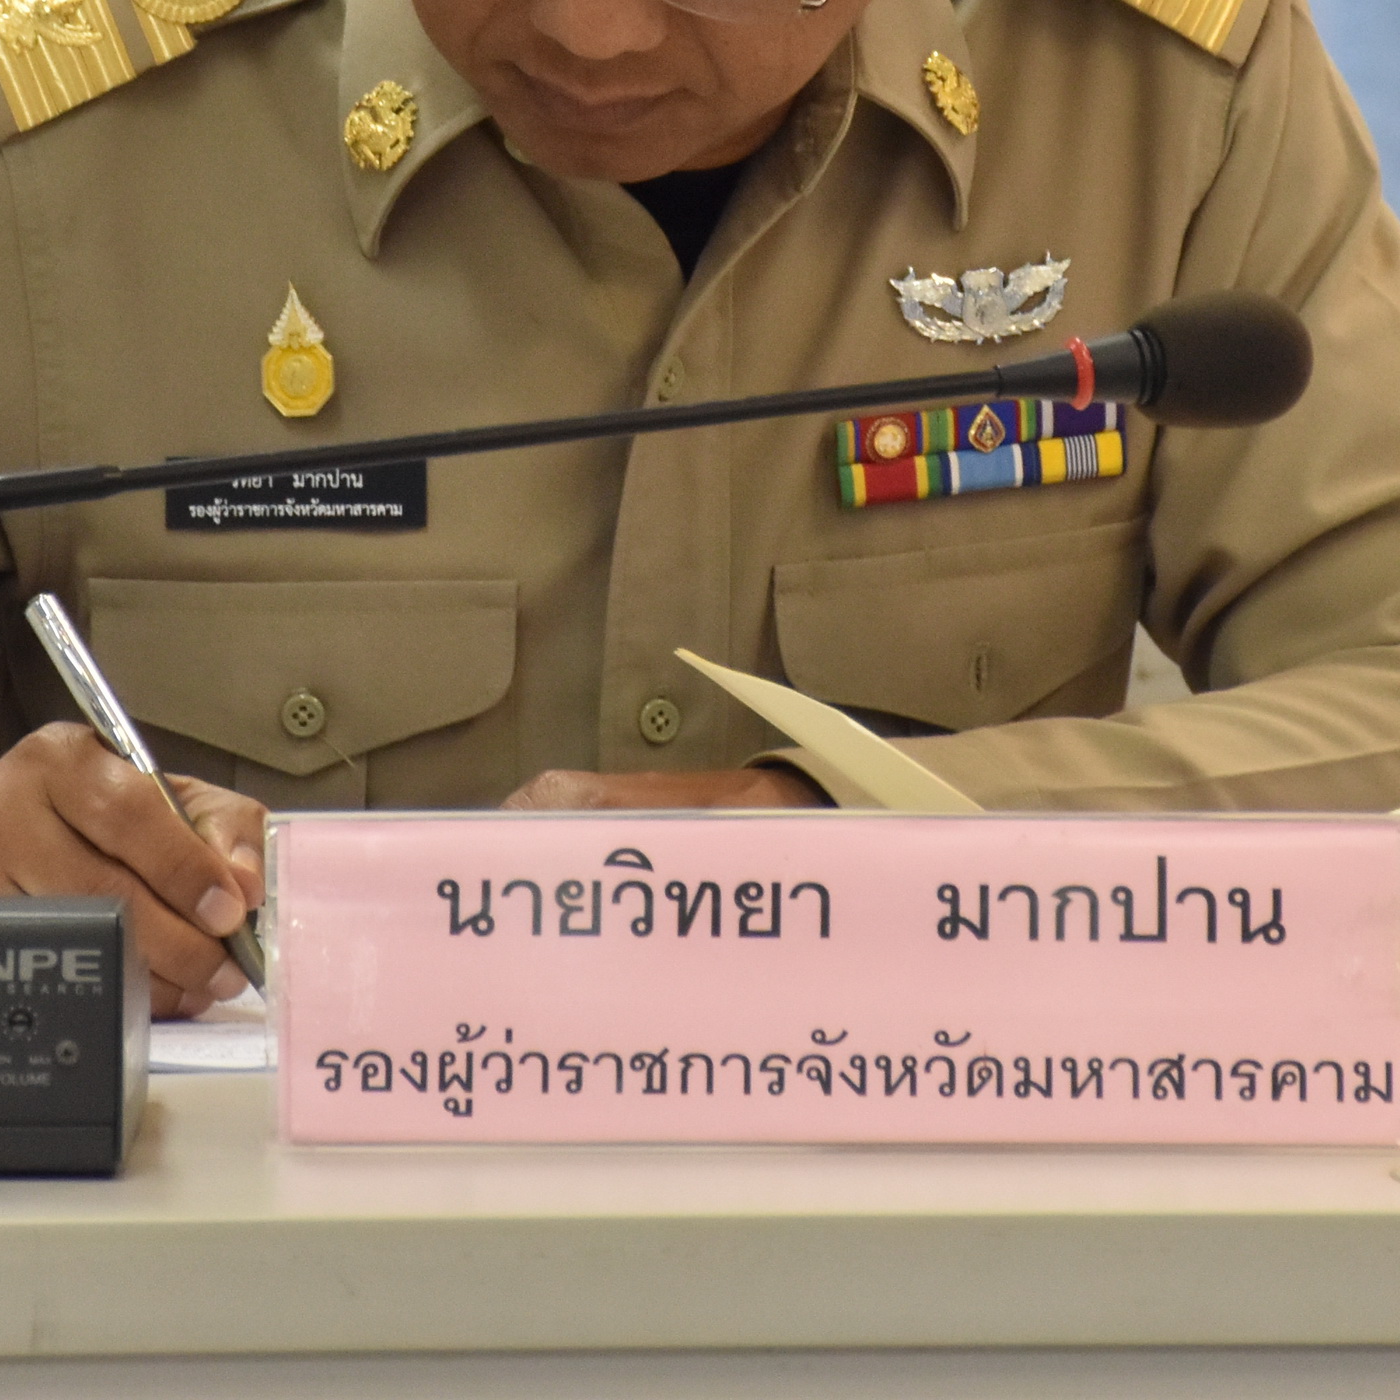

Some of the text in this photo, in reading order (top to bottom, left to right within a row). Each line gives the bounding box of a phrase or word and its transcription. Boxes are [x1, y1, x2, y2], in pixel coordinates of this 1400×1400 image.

[292, 467, 363, 489] มากปาน
[188, 497, 403, 525] รองผู้ว่าราชการจังหวัดมหาสารคาม
[436, 847, 1287, 946] นายวิทยา มากปาน
[315, 1022, 1395, 1118] รองผู้ว่าราชการจังหวัดมหาสารคาม
